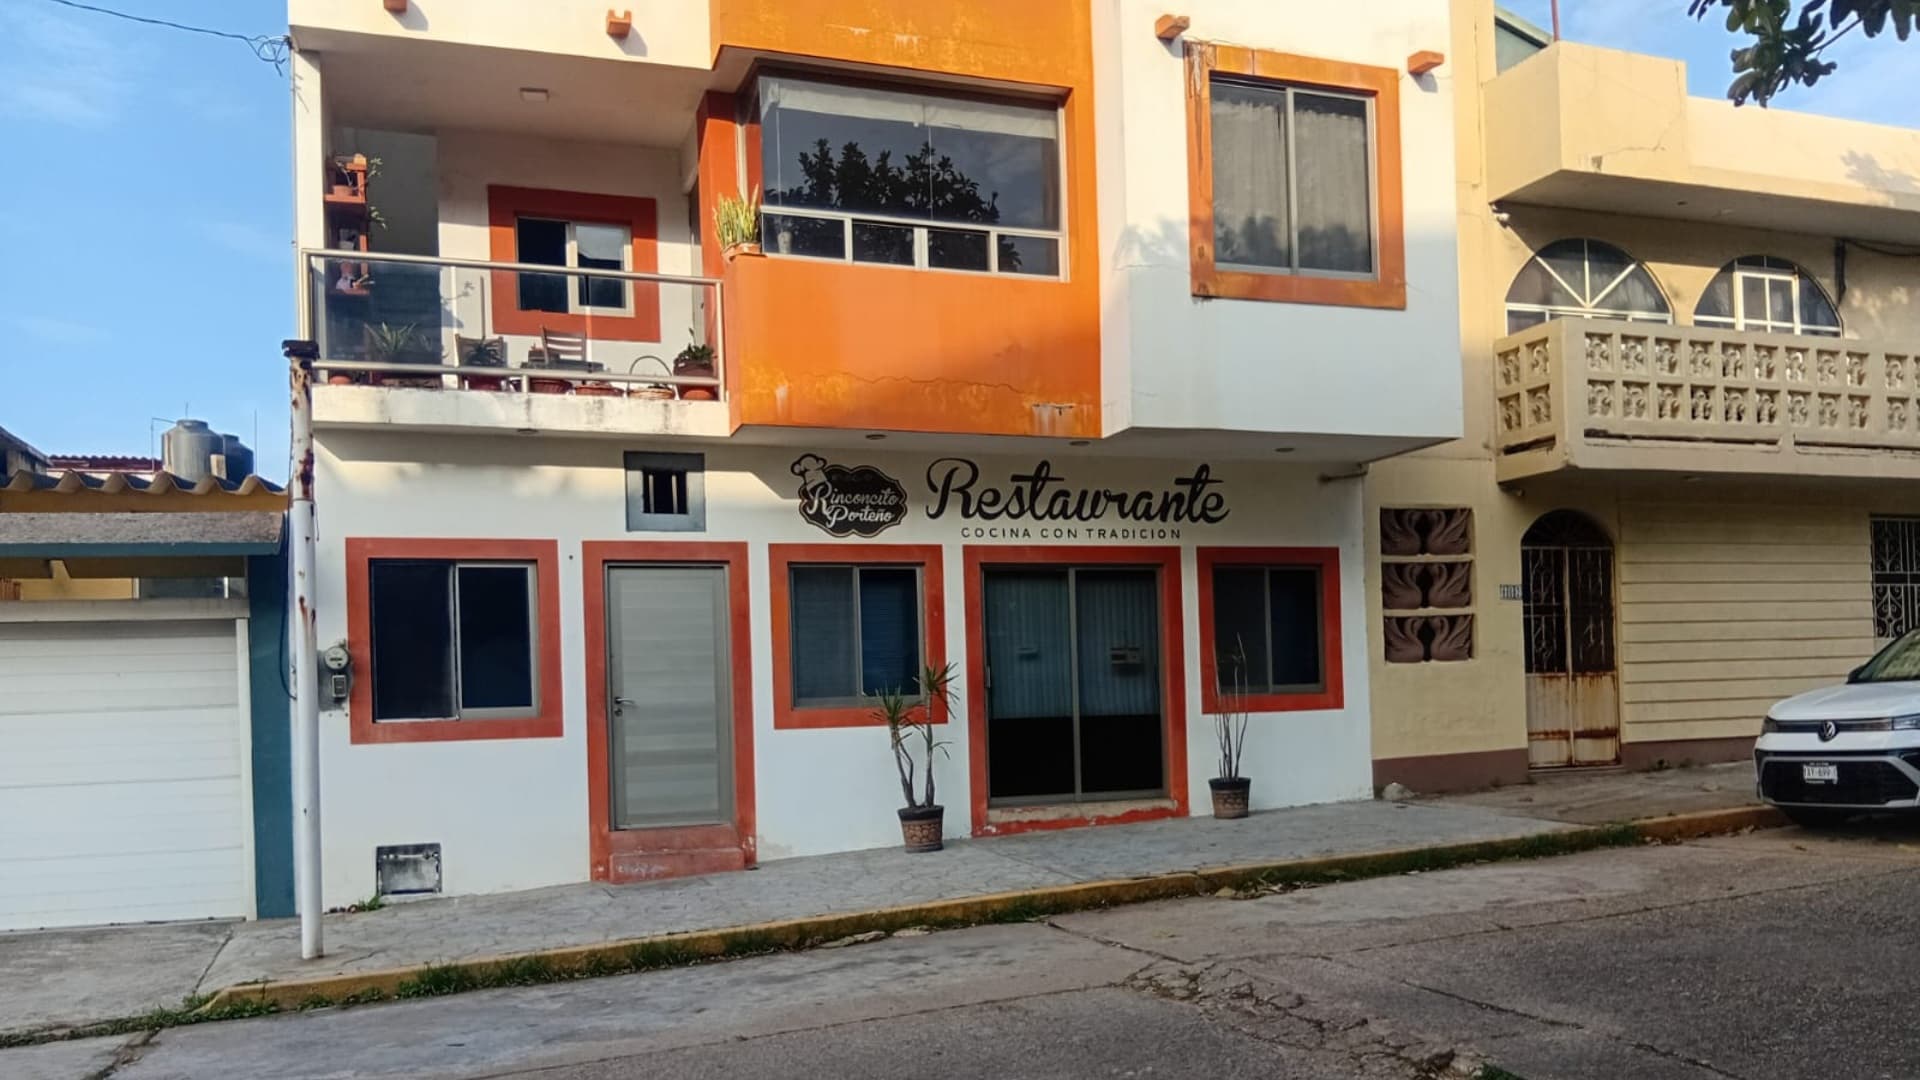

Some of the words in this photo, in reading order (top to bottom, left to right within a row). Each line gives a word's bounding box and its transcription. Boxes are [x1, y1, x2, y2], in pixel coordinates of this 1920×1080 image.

[806, 481, 898, 514] Rinconcito
[926, 457, 1230, 523] Restaurante
[825, 503, 894, 529] Porteño
[961, 527, 1031, 539] COCINA
[1040, 528, 1078, 539] CON
[1086, 528, 1181, 540] TRADICION
